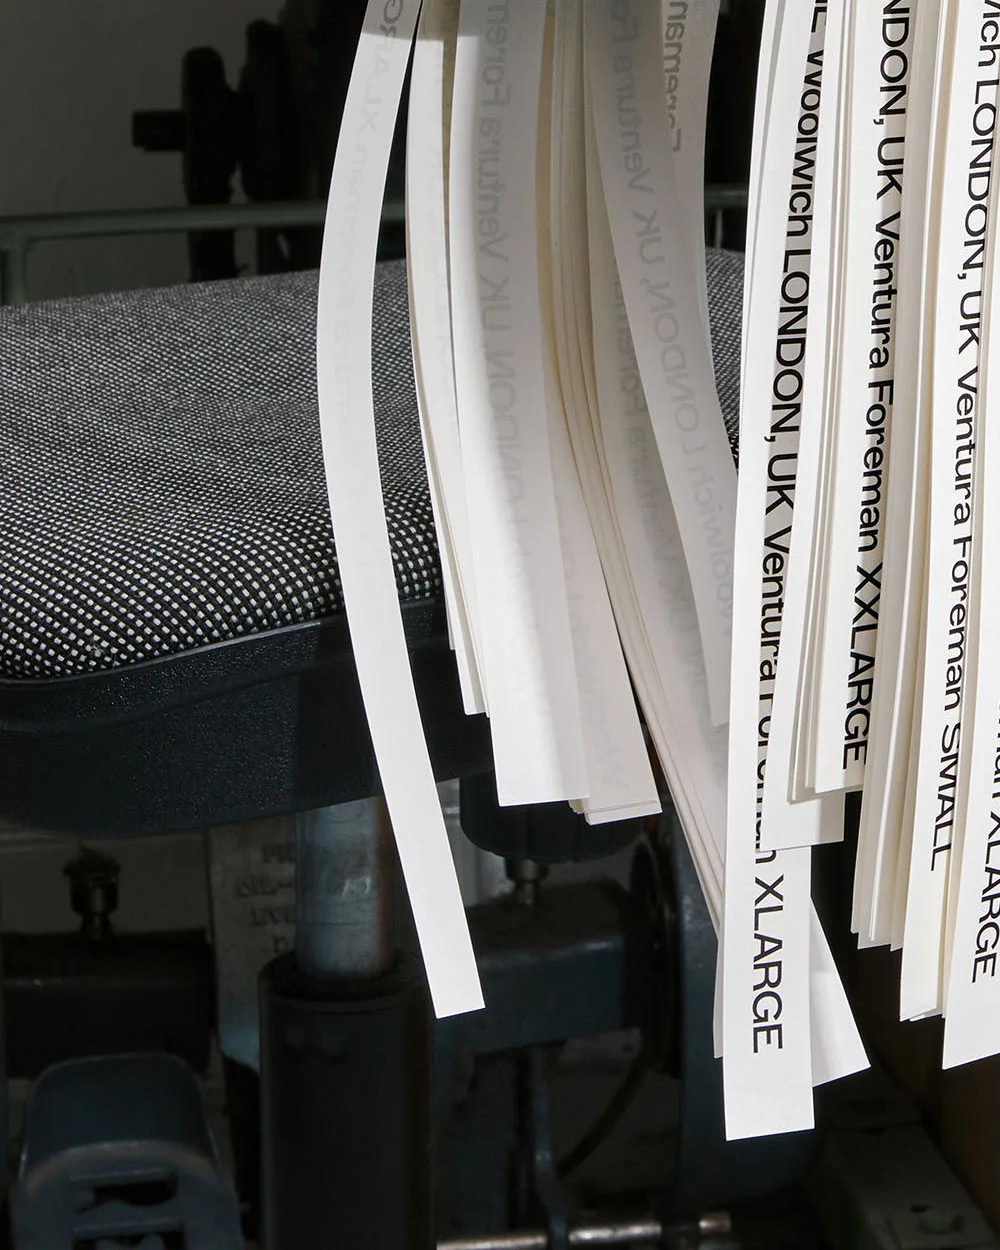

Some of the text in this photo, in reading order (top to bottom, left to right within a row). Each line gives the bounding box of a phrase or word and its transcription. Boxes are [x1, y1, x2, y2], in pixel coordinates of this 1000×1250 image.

[876, 137, 905, 200] UK
[957, 79, 1000, 280] LONDON,
[764, 249, 812, 443] LONDON,
[868, 211, 901, 370] Ventura
[958, 290, 982, 355] UK
[765, 453, 798, 515] UK
[858, 379, 894, 553] Foreman
[953, 366, 979, 526] Ventura
[759, 526, 793, 682] Ventura
[842, 562, 883, 770] XXLARGE
[943, 535, 972, 712] Foreman
[930, 723, 960, 872] SMALL
[752, 873, 785, 1054] XLARGE
